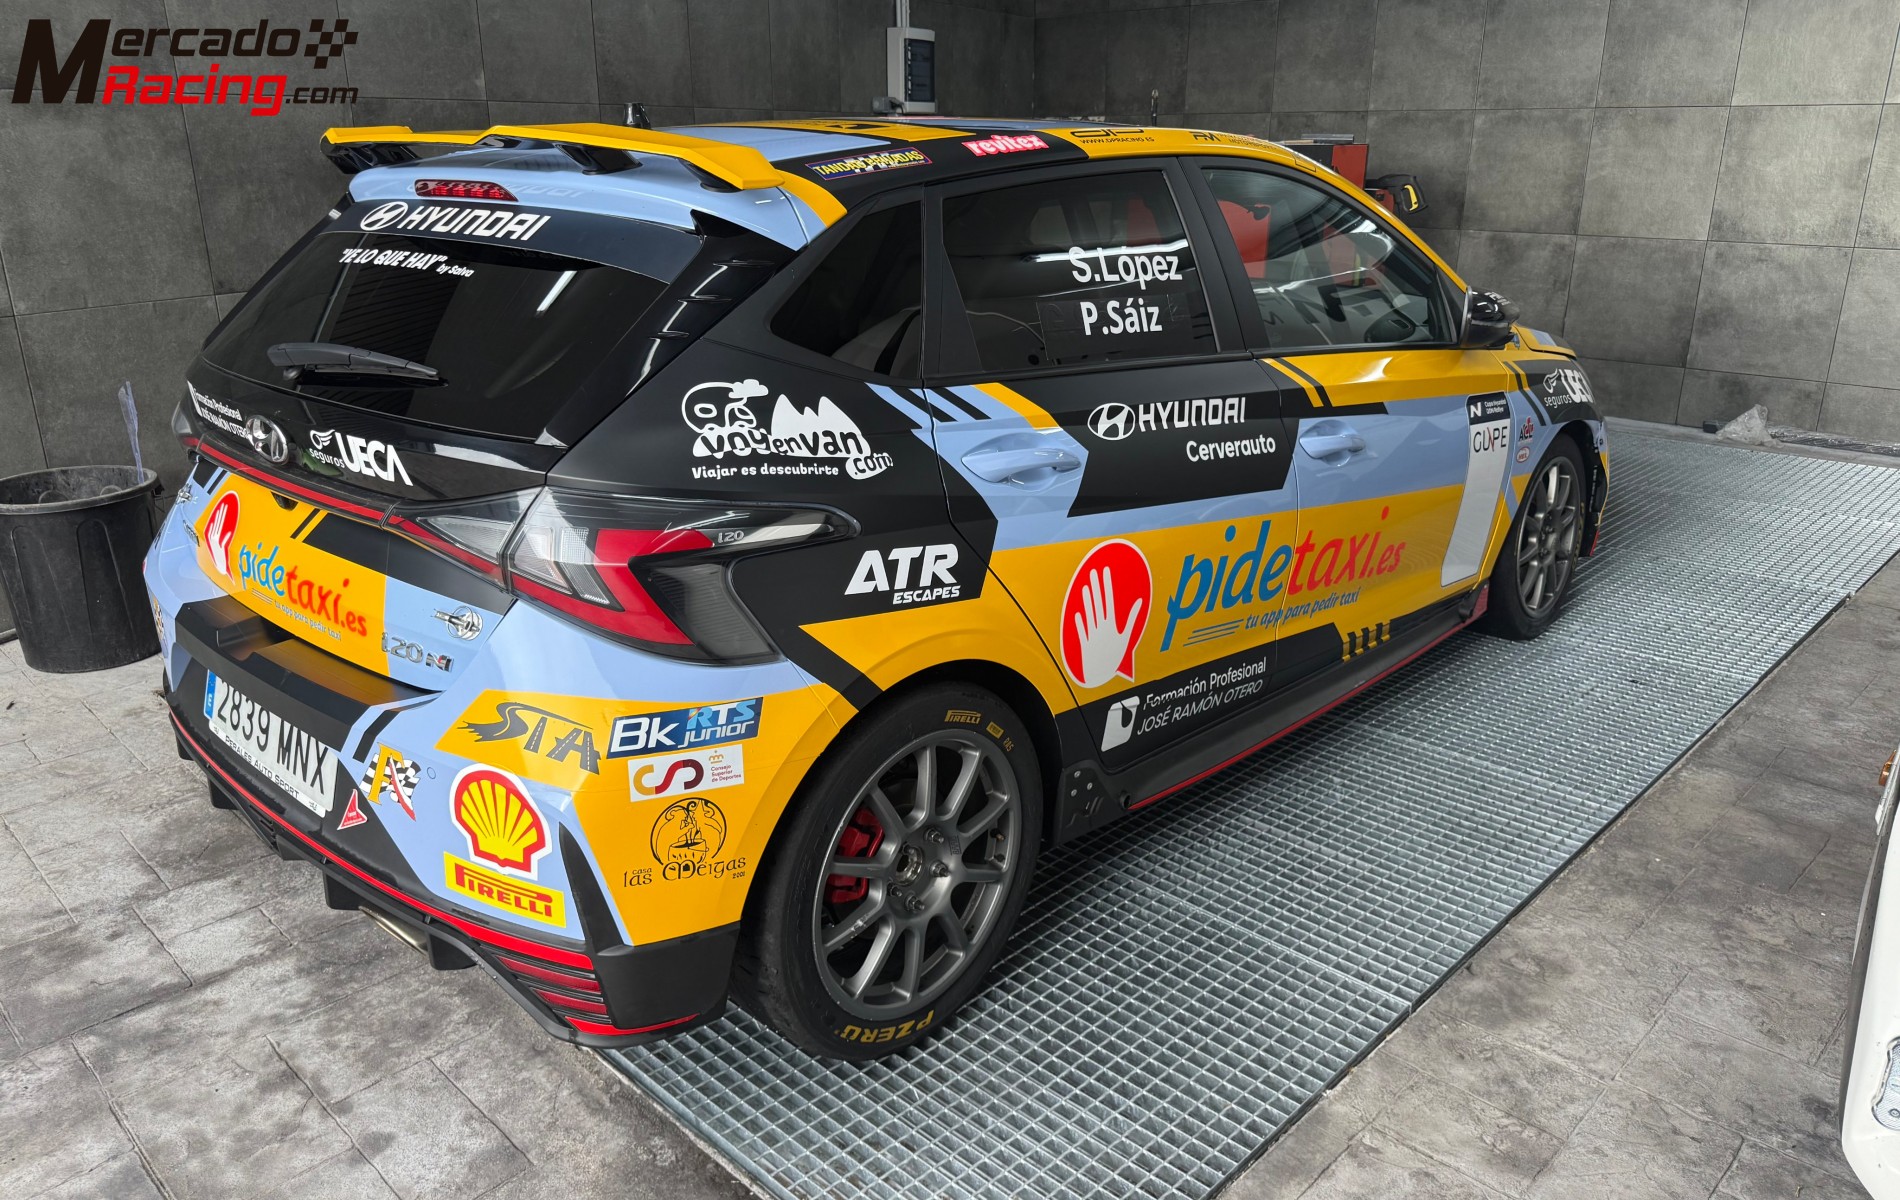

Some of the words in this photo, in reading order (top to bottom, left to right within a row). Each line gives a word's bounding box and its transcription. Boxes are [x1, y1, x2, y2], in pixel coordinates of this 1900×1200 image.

[964, 135, 1048, 156] revitex
[812, 159, 867, 175] TANDAS
[863, 151, 925, 167] PRIVADAS
[397, 205, 551, 241] HYUNDAI
[360, 249, 374, 265] LO
[374, 249, 411, 267] QUE
[436, 264, 449, 275] by
[449, 265, 475, 277] Salva
[1068, 246, 1183, 291] S.López
[1080, 298, 1163, 335] P.Sáiz
[1138, 397, 1246, 432] HYUNDAI
[1544, 394, 1572, 409] seguros
[309, 448, 345, 469] seguros
[334, 432, 414, 487] UECA
[1186, 434, 1276, 462] Cerverauto
[692, 465, 737, 480] Viajar
[741, 466, 757, 476] es
[760, 463, 839, 476] descubrirte
[844, 543, 959, 595] ATR
[893, 585, 961, 605] ESCAPES
[1245, 614, 1258, 629] tu
[1261, 610, 1284, 627] app
[1284, 605, 1310, 625] para
[1311, 595, 1338, 618] pedir
[1340, 587, 1361, 607] taxi
[294, 610, 309, 624] para
[310, 617, 327, 632] pedir
[328, 627, 341, 641] taxi
[1143, 677, 1207, 710] Formación
[1209, 656, 1267, 690] Profesional
[686, 699, 757, 730] RTS
[944, 710, 981, 724] PIRELLI
[1137, 704, 1171, 735] JOSÉ
[1171, 692, 1222, 723] RAMÓN
[1224, 679, 1263, 704] OTERO
[217, 680, 270, 752] 2839
[276, 718, 329, 796] MNX
[225, 735, 252, 764] PERALES
[254, 759, 273, 779] AUTO
[274, 774, 300, 799] SPORT
[719, 774, 742, 782] Deportes
[624, 870, 652, 887] las
[632, 867, 652, 876] casa
[454, 863, 553, 917] PIRELLI
